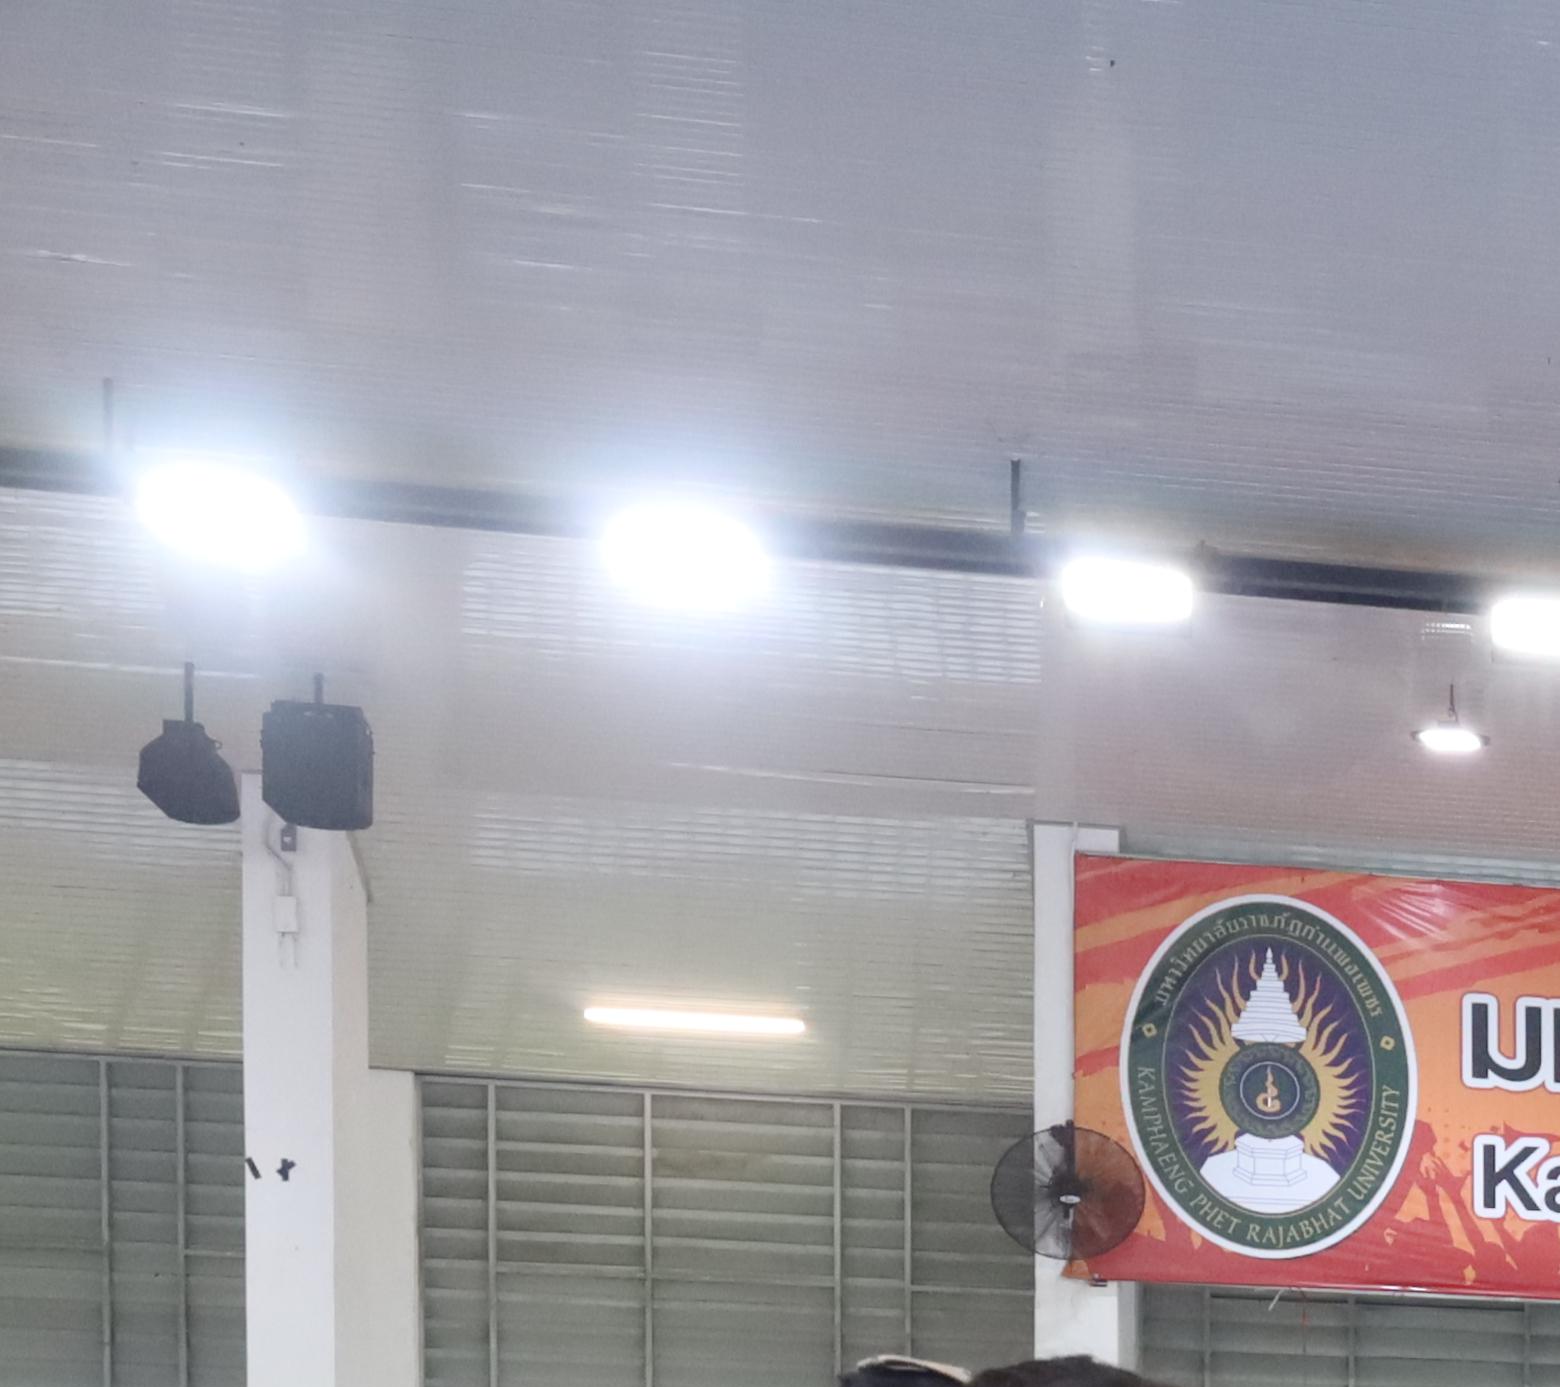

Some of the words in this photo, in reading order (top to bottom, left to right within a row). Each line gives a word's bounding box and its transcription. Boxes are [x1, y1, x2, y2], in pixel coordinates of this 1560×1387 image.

[1137, 1065, 1192, 1195] KAMPHAENG
[1189, 1193, 1241, 1236] PHET
[1247, 1198, 1348, 1248] RAJABHAT
[1350, 1084, 1401, 1202] UNIVERSITY
